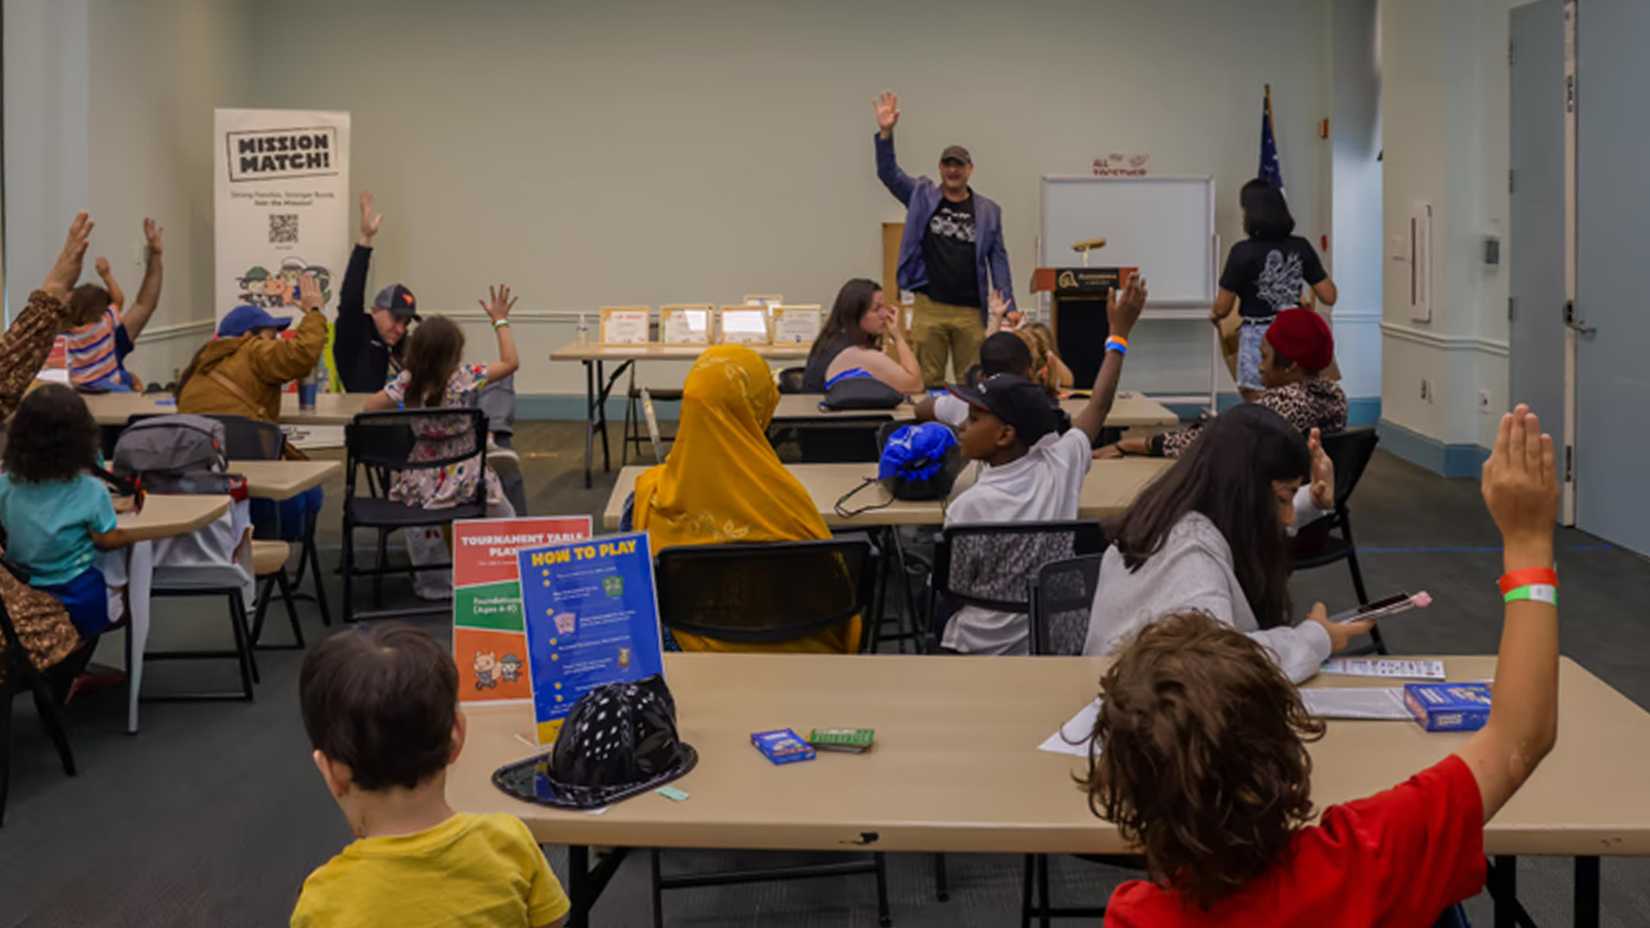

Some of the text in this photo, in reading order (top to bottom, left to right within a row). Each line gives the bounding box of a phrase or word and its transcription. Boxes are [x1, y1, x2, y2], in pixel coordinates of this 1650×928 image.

[239, 134, 328, 153] MISSION
[240, 151, 330, 173] MATCH!
[461, 533, 544, 545] TOURNAMENT
[531, 550, 571, 567] HOW
[574, 546, 596, 561] TO
[599, 540, 637, 557] PLAY
